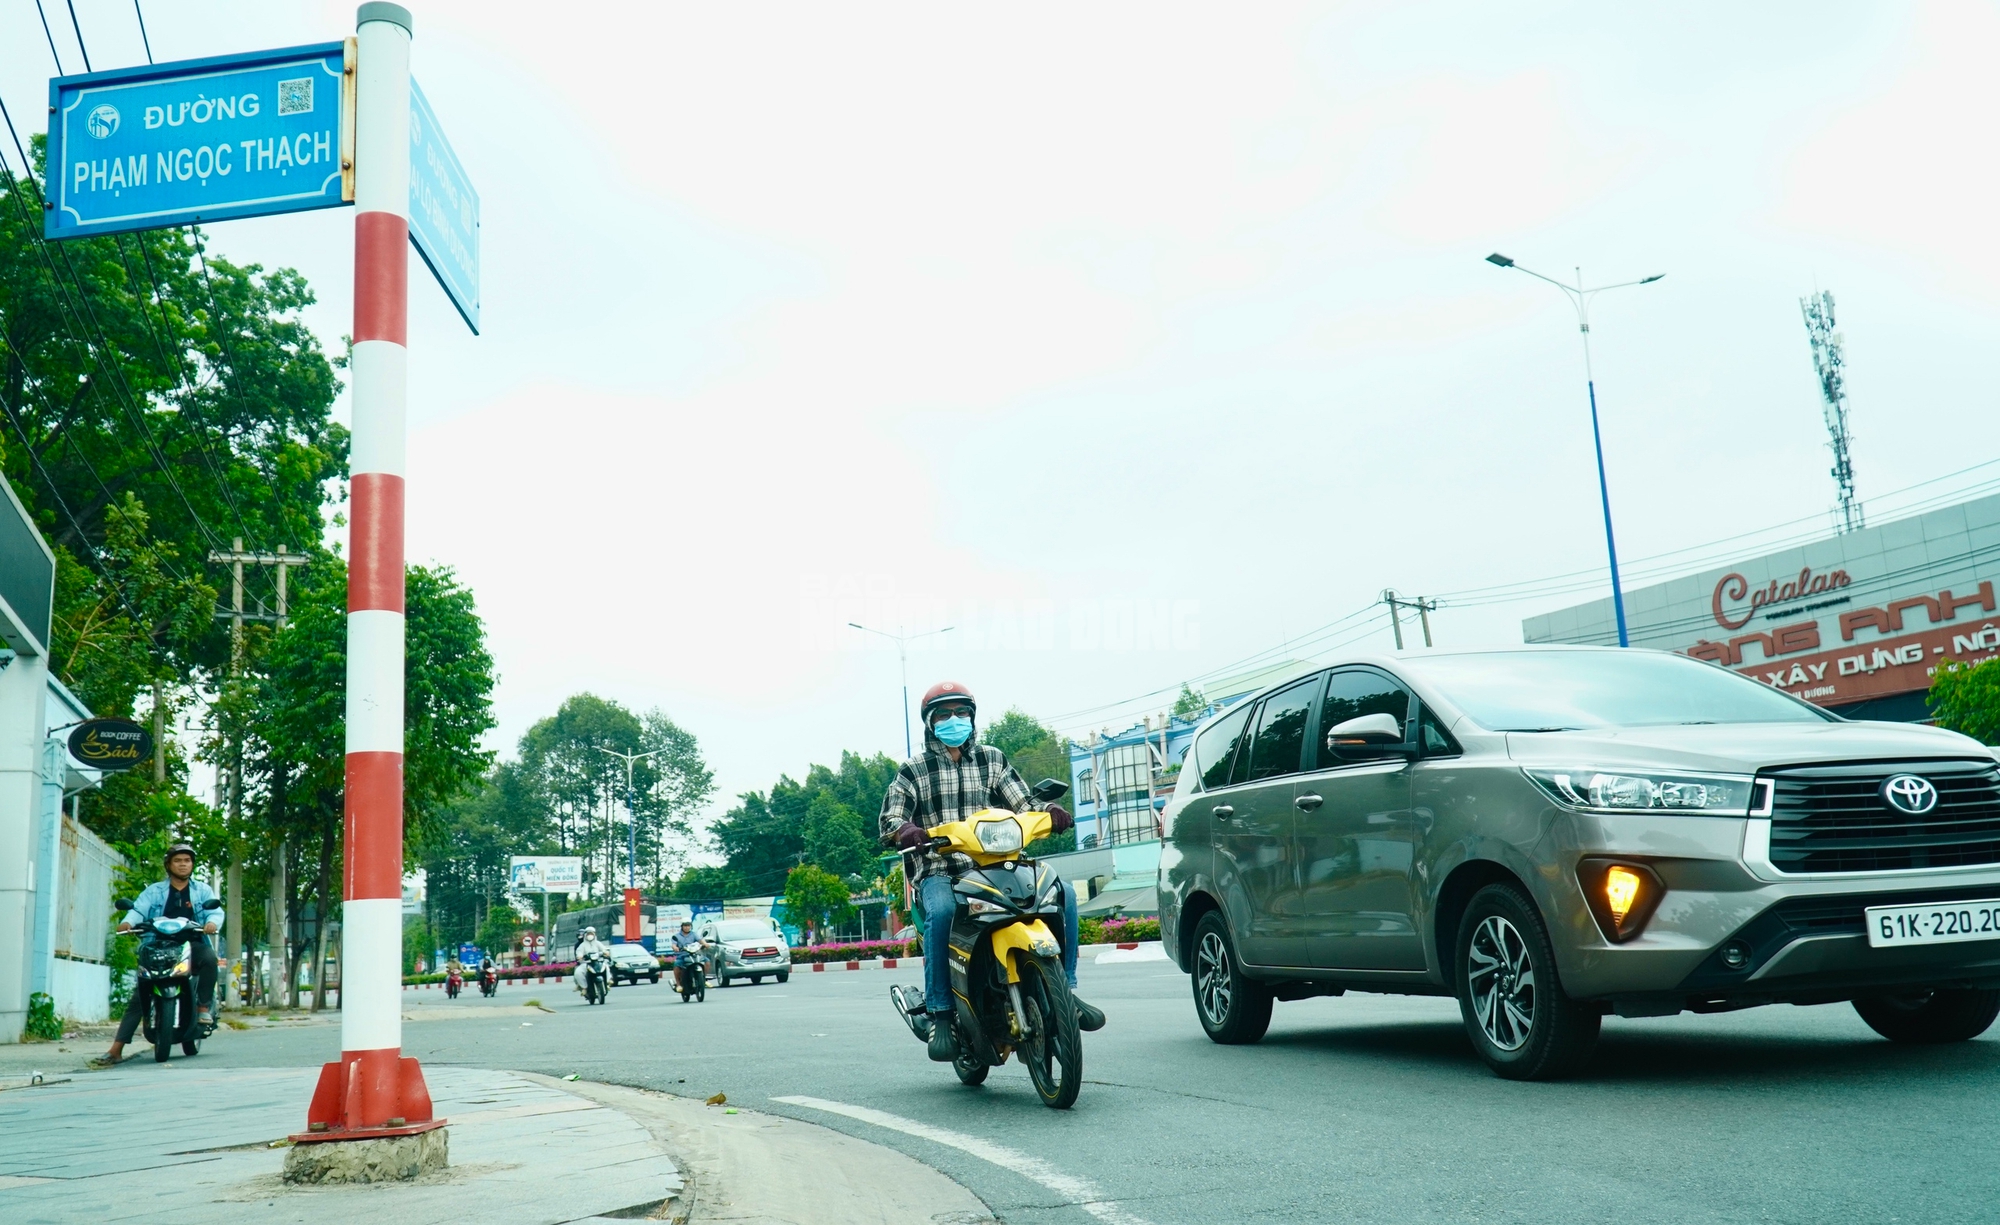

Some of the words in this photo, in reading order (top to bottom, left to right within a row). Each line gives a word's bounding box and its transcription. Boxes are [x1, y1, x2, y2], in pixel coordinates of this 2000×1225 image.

[143, 93, 260, 130] ĐƯỜNG
[73, 153, 148, 197] PHẠM
[156, 141, 233, 187] NGỌC
[240, 130, 331, 177] THẠCH
[427, 141, 458, 210] ĐƯỜNG
[1711, 566, 1852, 630] Catalan
[1838, 580, 1996, 640] ANH
[1767, 661, 1828, 688] XÂY
[1838, 643, 1924, 676] DỰNG
[116, 731, 142, 741] COFFEE
